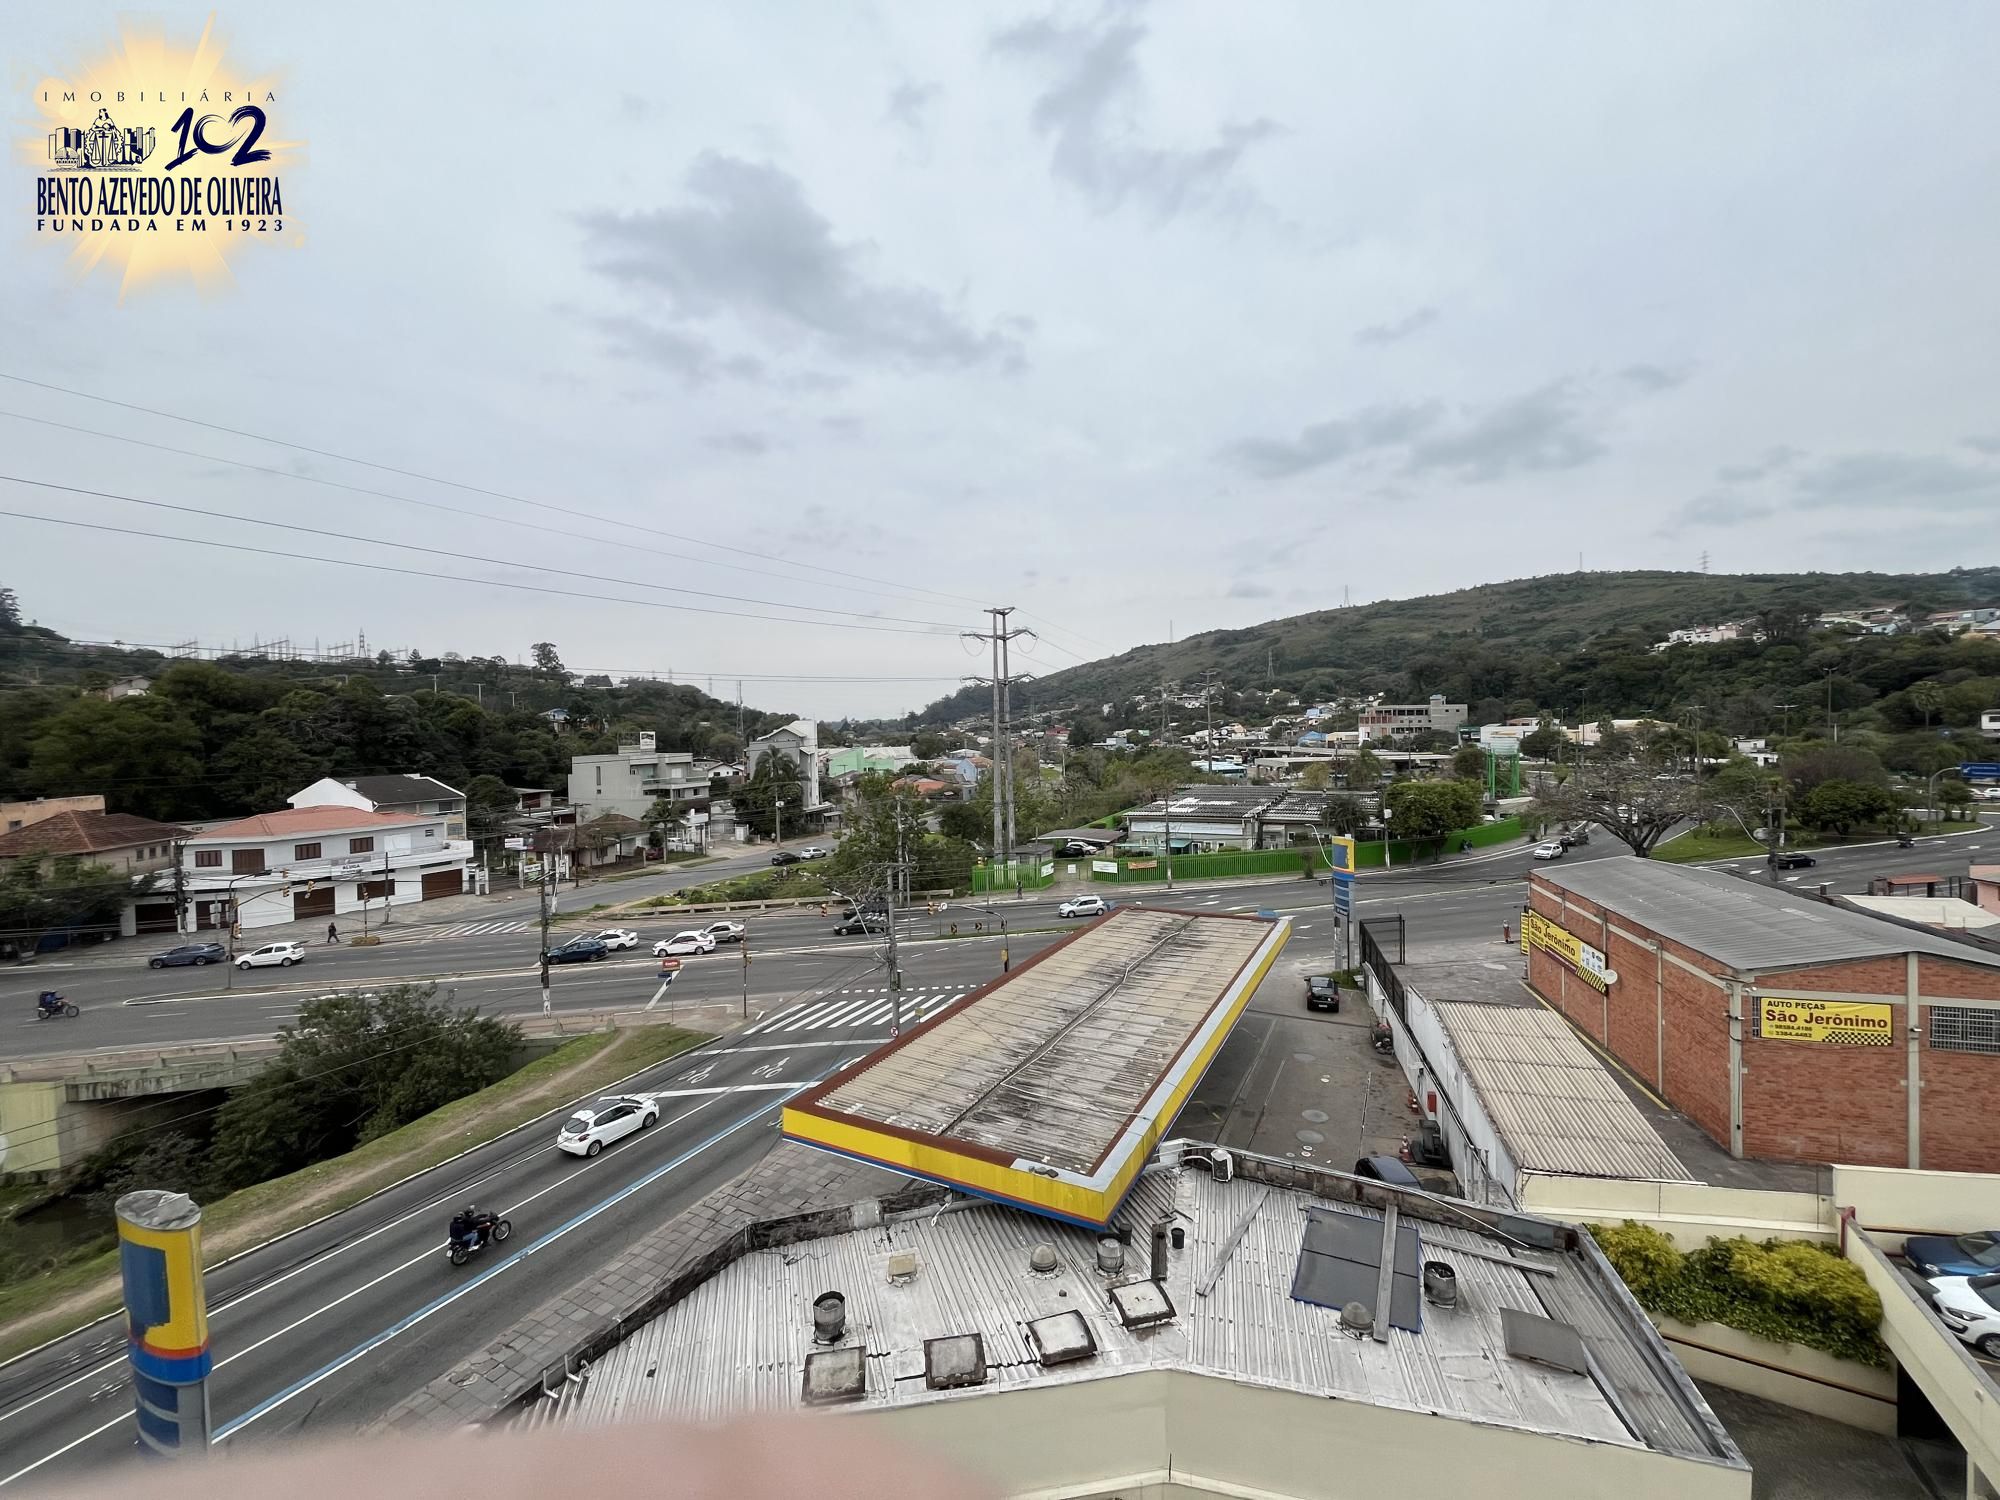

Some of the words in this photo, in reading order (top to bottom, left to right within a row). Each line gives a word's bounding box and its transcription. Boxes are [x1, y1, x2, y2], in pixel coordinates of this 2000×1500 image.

[1530, 918, 1541, 934] São
[1543, 926, 1576, 956] Jerônimo
[1795, 1002, 1826, 1010] PEÇAS
[1765, 1009, 1798, 1023] São
[1804, 1012, 1888, 1029] Jerônimo
